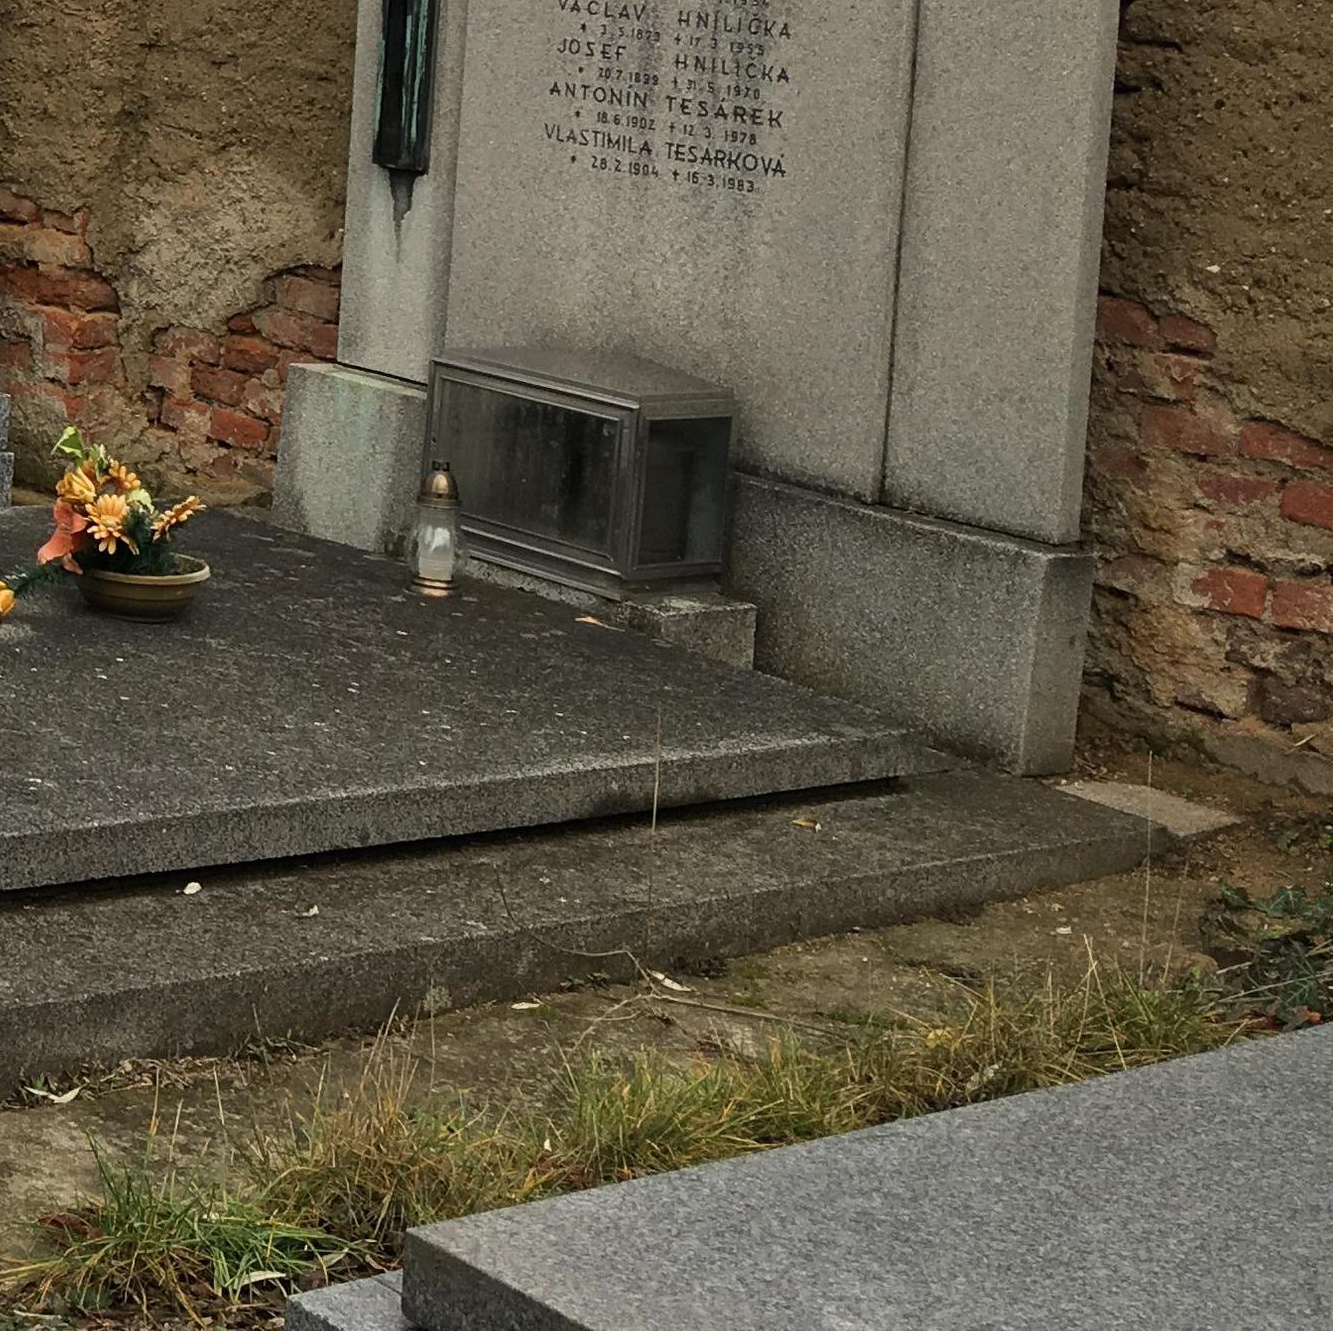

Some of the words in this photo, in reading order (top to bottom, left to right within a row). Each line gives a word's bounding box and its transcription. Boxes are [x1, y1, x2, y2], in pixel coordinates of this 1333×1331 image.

[677, 9, 792, 41] HNILIČKA
[556, 37, 627, 62] JOSEF
[674, 53, 791, 84] HNILIČKA
[548, 81, 649, 109] ANTONÍN
[665, 95, 784, 129] TESÁREK
[542, 123, 654, 156] VLASTIMILA
